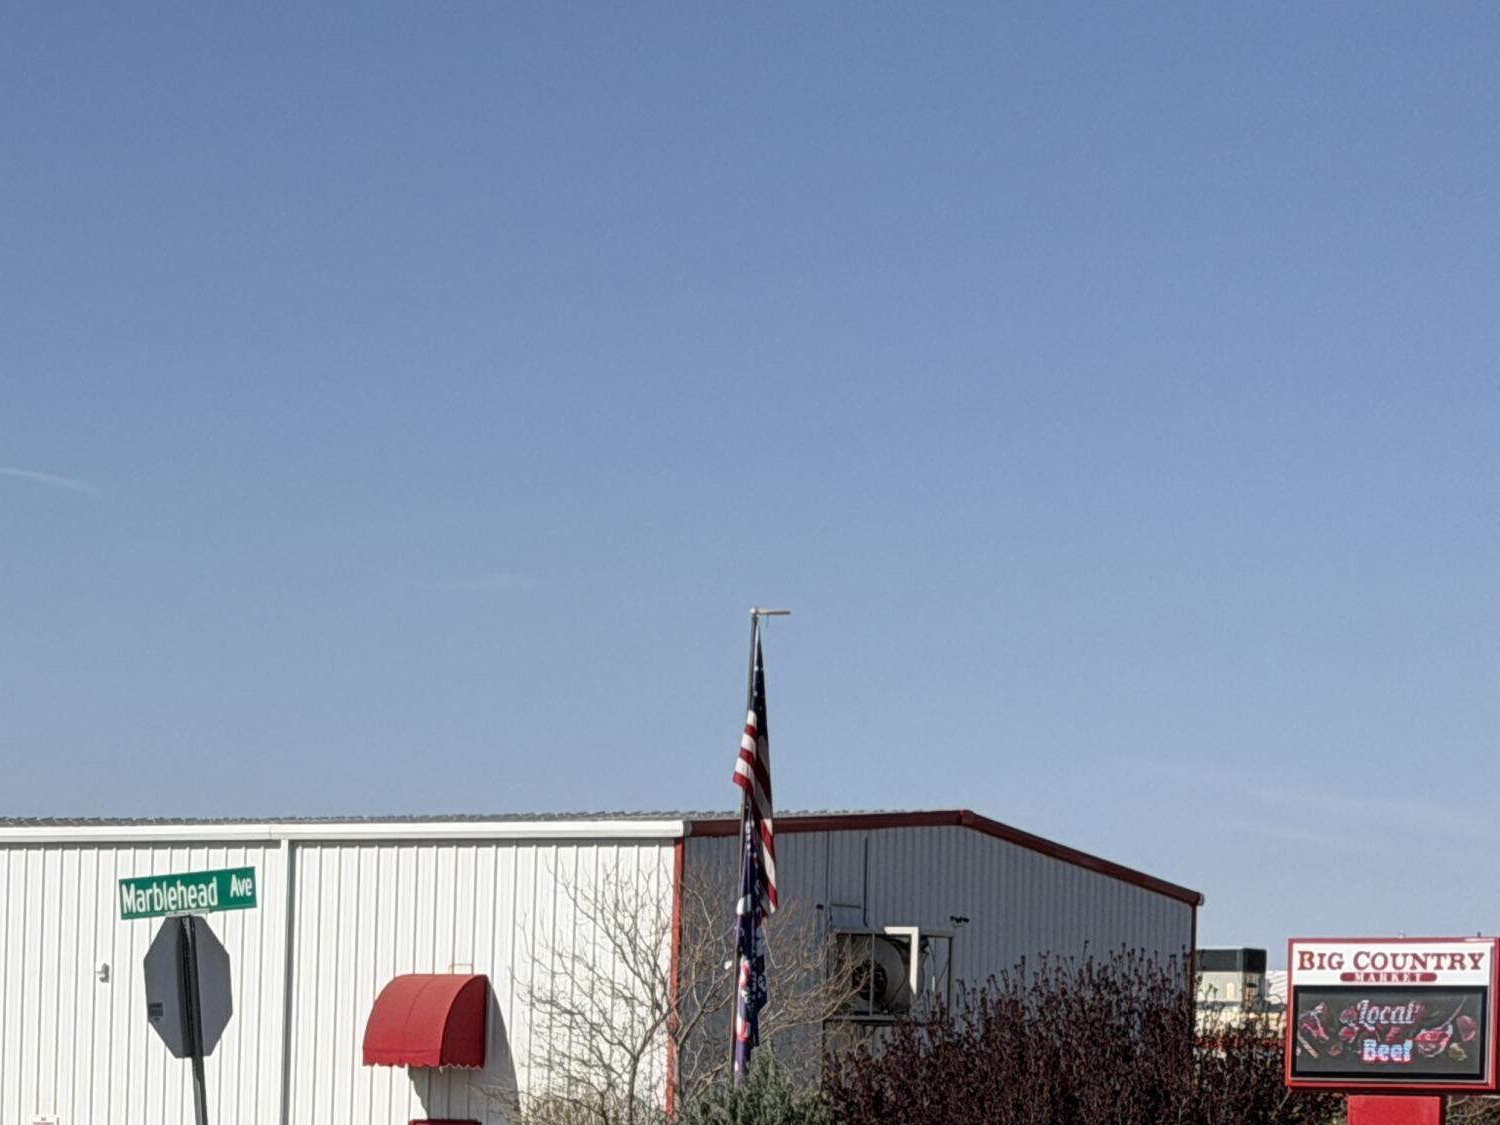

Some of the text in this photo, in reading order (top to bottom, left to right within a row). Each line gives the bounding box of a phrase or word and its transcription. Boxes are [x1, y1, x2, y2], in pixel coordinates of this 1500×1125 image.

[121, 874, 253, 914] Marblehead Ave
[1297, 950, 1485, 971] BIG COUNTRY
[1362, 1038, 1413, 1063] Beef
